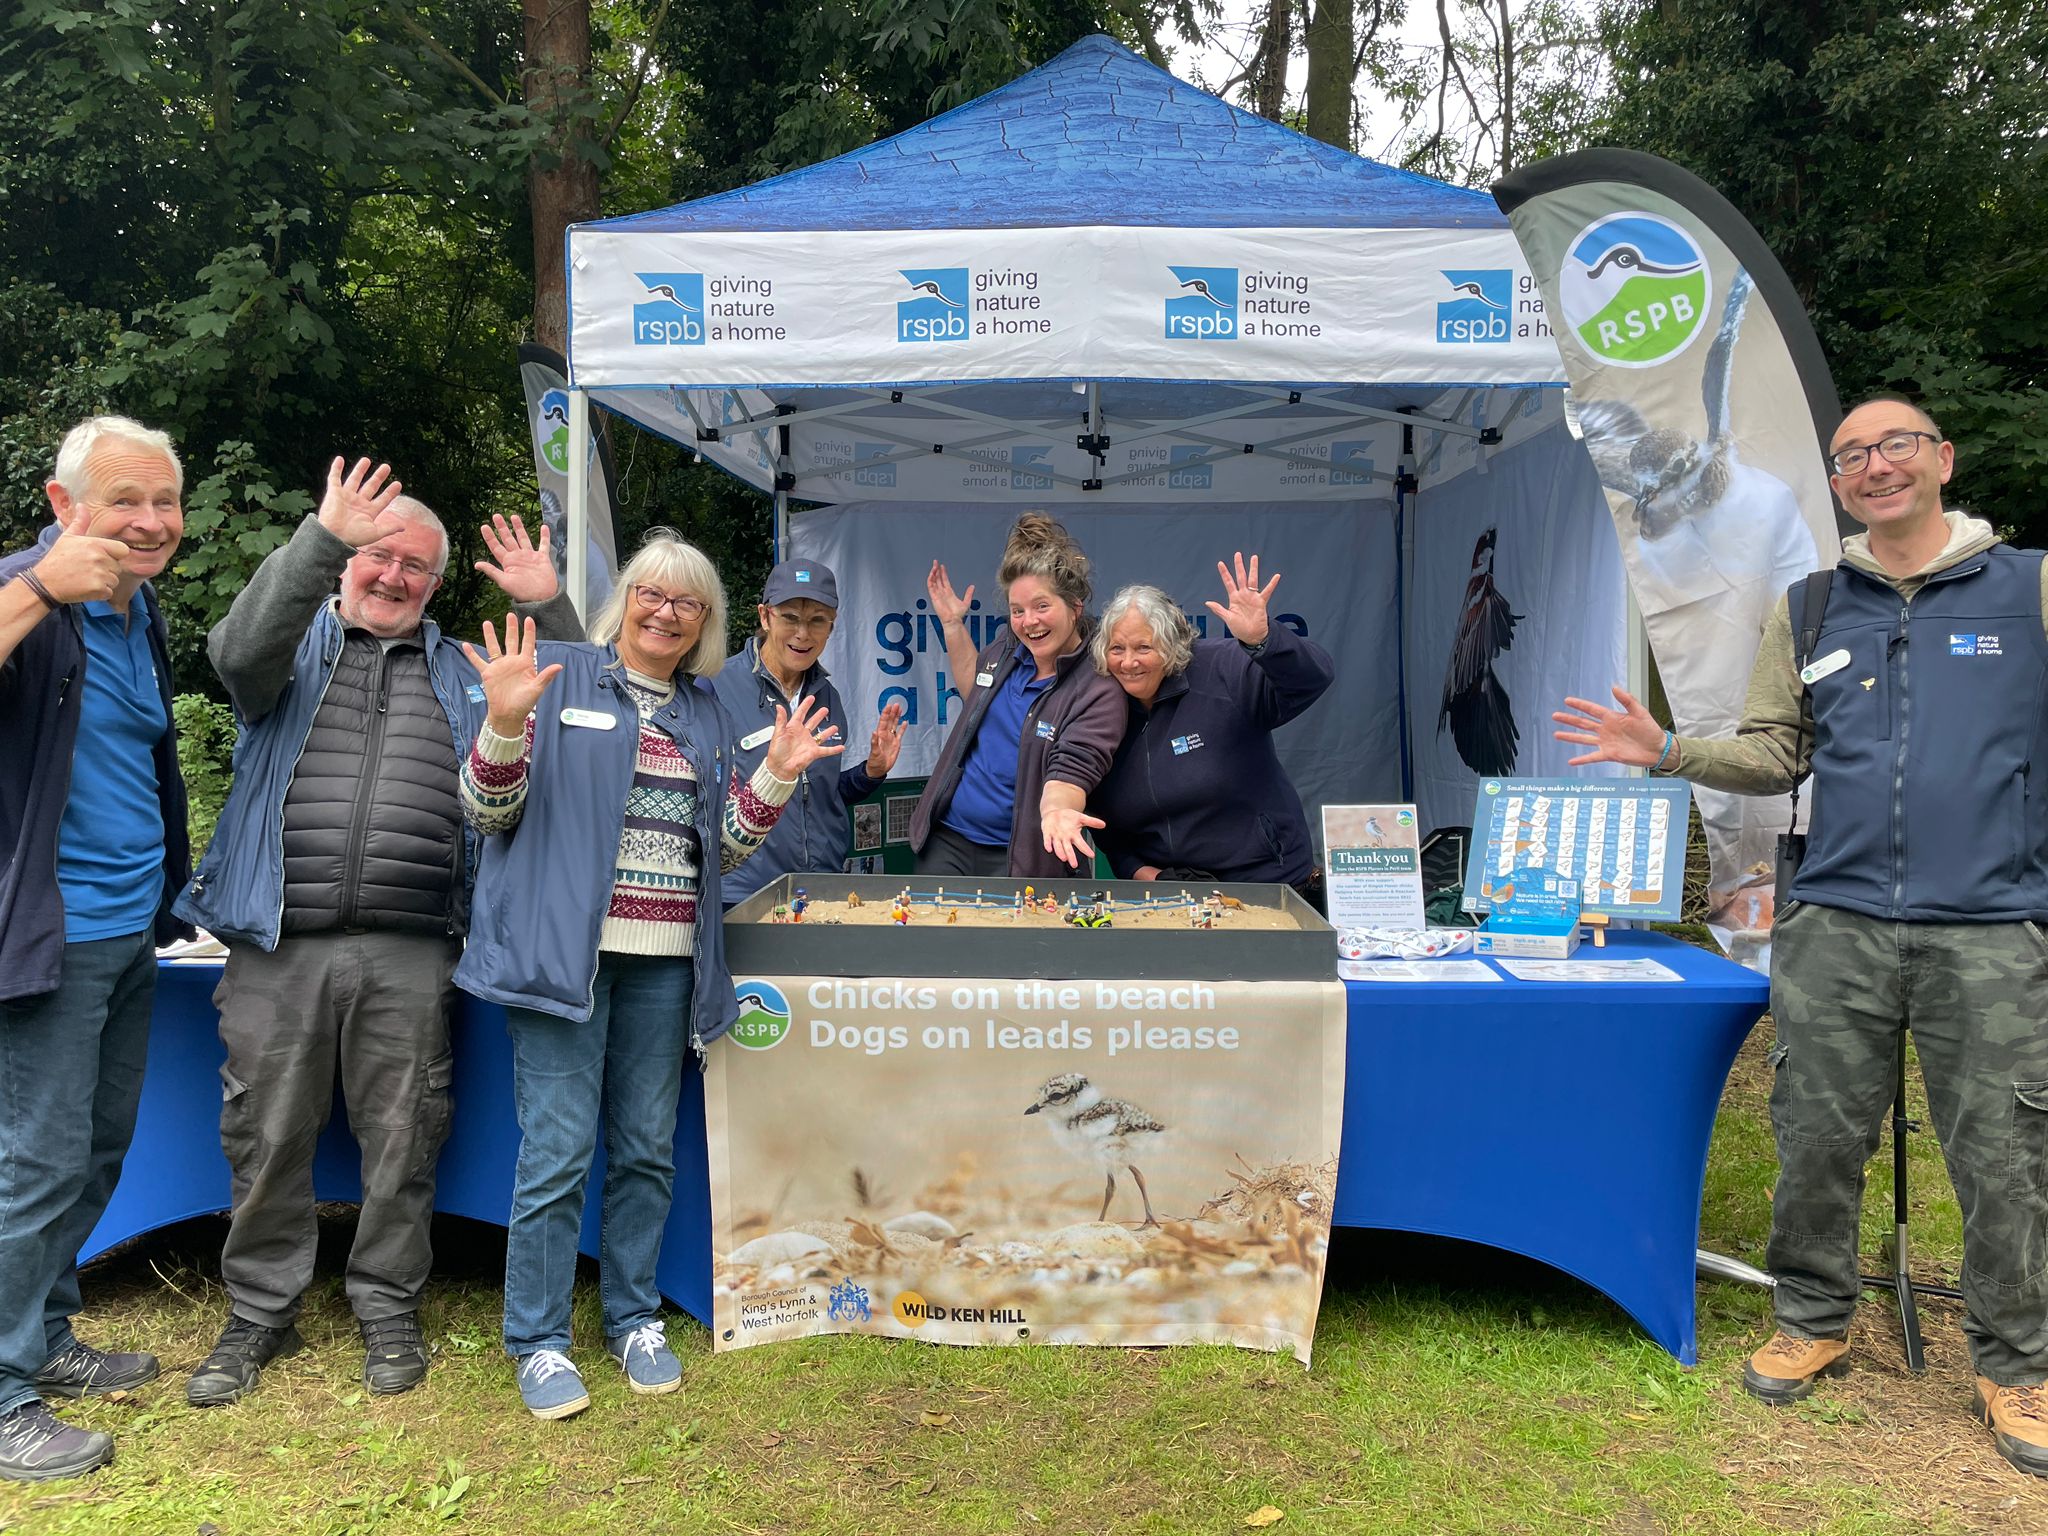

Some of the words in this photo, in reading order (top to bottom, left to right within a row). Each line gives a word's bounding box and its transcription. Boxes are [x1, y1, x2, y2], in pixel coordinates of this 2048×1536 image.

[709, 276, 772, 298] giving
[975, 268, 1038, 290] giving
[1244, 271, 1309, 294] giving
[711, 299, 775, 317] nature
[976, 292, 1040, 310] nature
[1244, 296, 1310, 314] nature
[639, 315, 702, 345] rspb
[711, 326, 722, 340] a
[727, 322, 786, 341] home
[903, 312, 964, 342] rspb
[976, 320, 988, 334] a
[992, 316, 1051, 334] home
[1169, 310, 1234, 339] rspb
[1244, 321, 1256, 336] a
[1262, 317, 1321, 337] home
[1440, 315, 1507, 343] rspb
[1518, 323, 1529, 337] a
[1598, 294, 1695, 349] RSPB
[876, 599, 1010, 676] givin
[1977, 635, 1999, 643] giving
[1526, 785, 1546, 793] things
[1571, 785, 1581, 793] big
[1337, 852, 1381, 864] Thank
[1384, 854, 1409, 866] you
[807, 980, 938, 1010] Chicks
[951, 986, 999, 1010] on
[1014, 982, 1081, 1010] the
[1095, 982, 1215, 1010] beach
[734, 1023, 780, 1037] RSPB
[810, 1019, 909, 1056] Dogs
[922, 1026, 970, 1049] on
[986, 1019, 1093, 1050] leads
[1108, 1019, 1240, 1057] please
[741, 1290, 771, 1302] Borough
[772, 1287, 798, 1298] Council
[799, 1286, 807, 1294] of
[741, 1301, 777, 1316] King's
[779, 1296, 806, 1311] Lynn
[809, 1295, 817, 1305] &
[902, 1302, 947, 1320] WILD
[951, 1308, 985, 1323] KEN
[990, 1309, 1026, 1323] HILL
[742, 1317, 773, 1330] West
[775, 1309, 819, 1325] Norfolk
